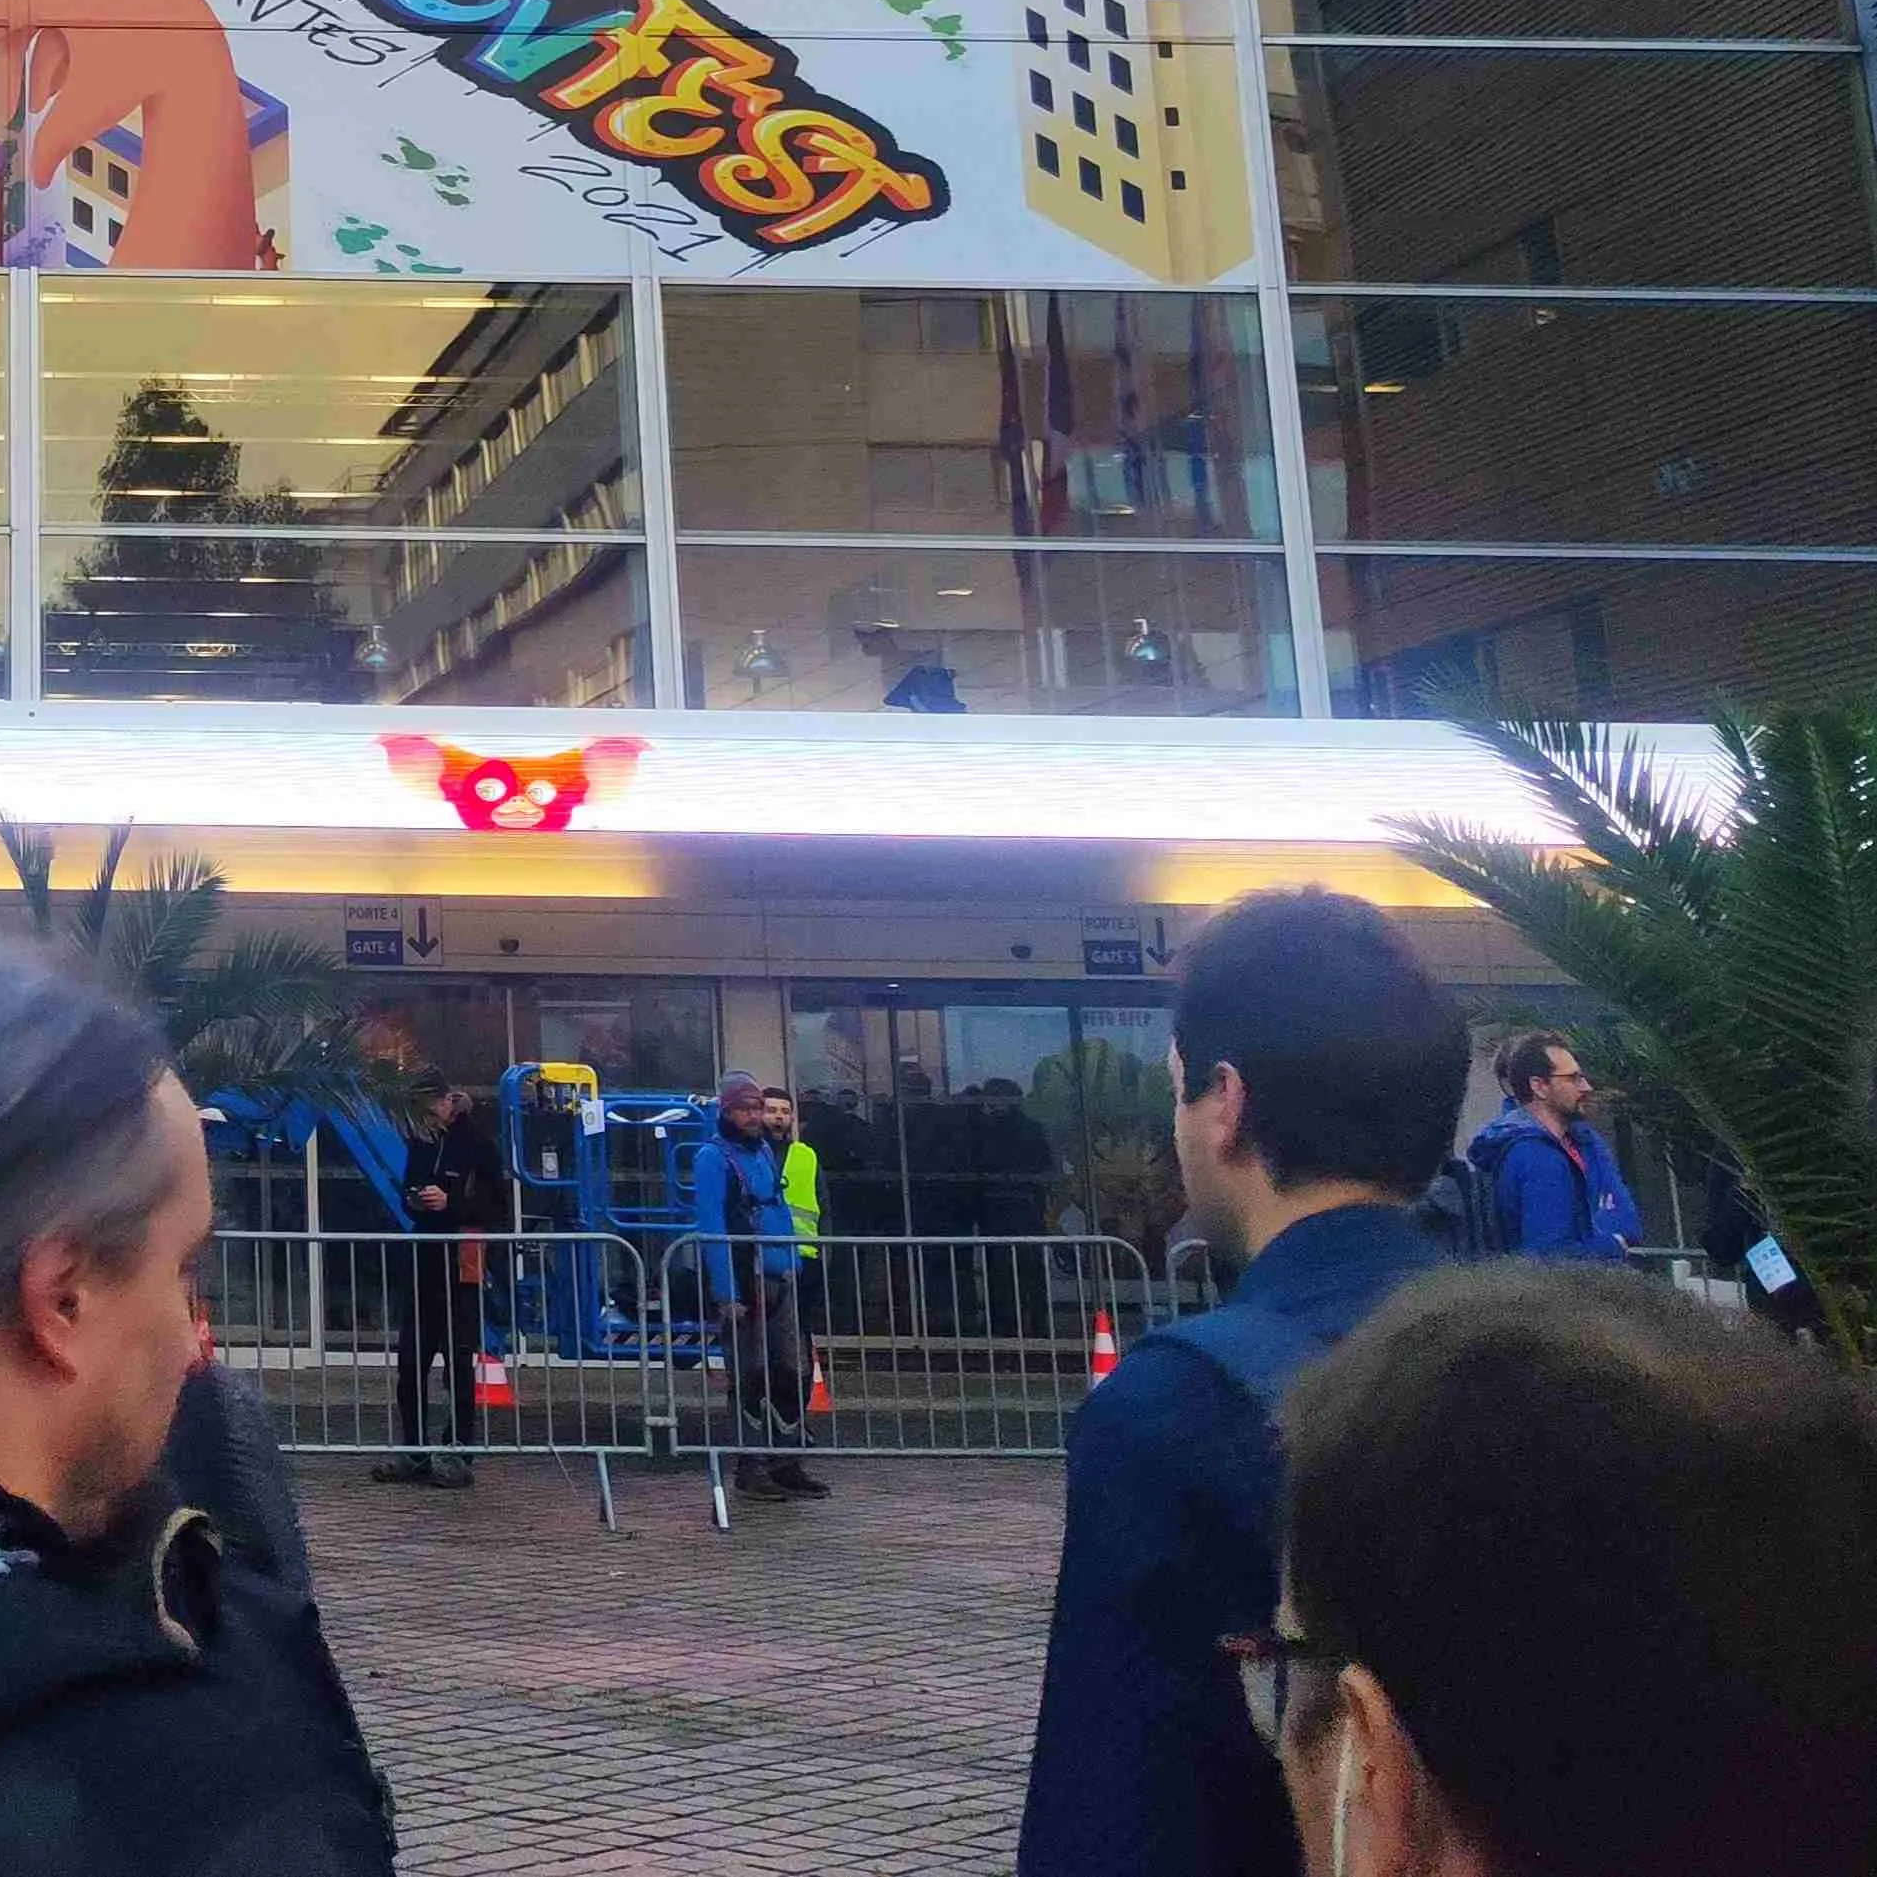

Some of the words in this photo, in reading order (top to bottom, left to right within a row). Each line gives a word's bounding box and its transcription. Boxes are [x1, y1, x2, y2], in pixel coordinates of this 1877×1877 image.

[518, 155, 723, 262] 2021
[348, 907, 387, 920] PORTE
[390, 907, 398, 919] 4
[352, 940, 386, 955] GATE
[388, 941, 397, 954] 4
